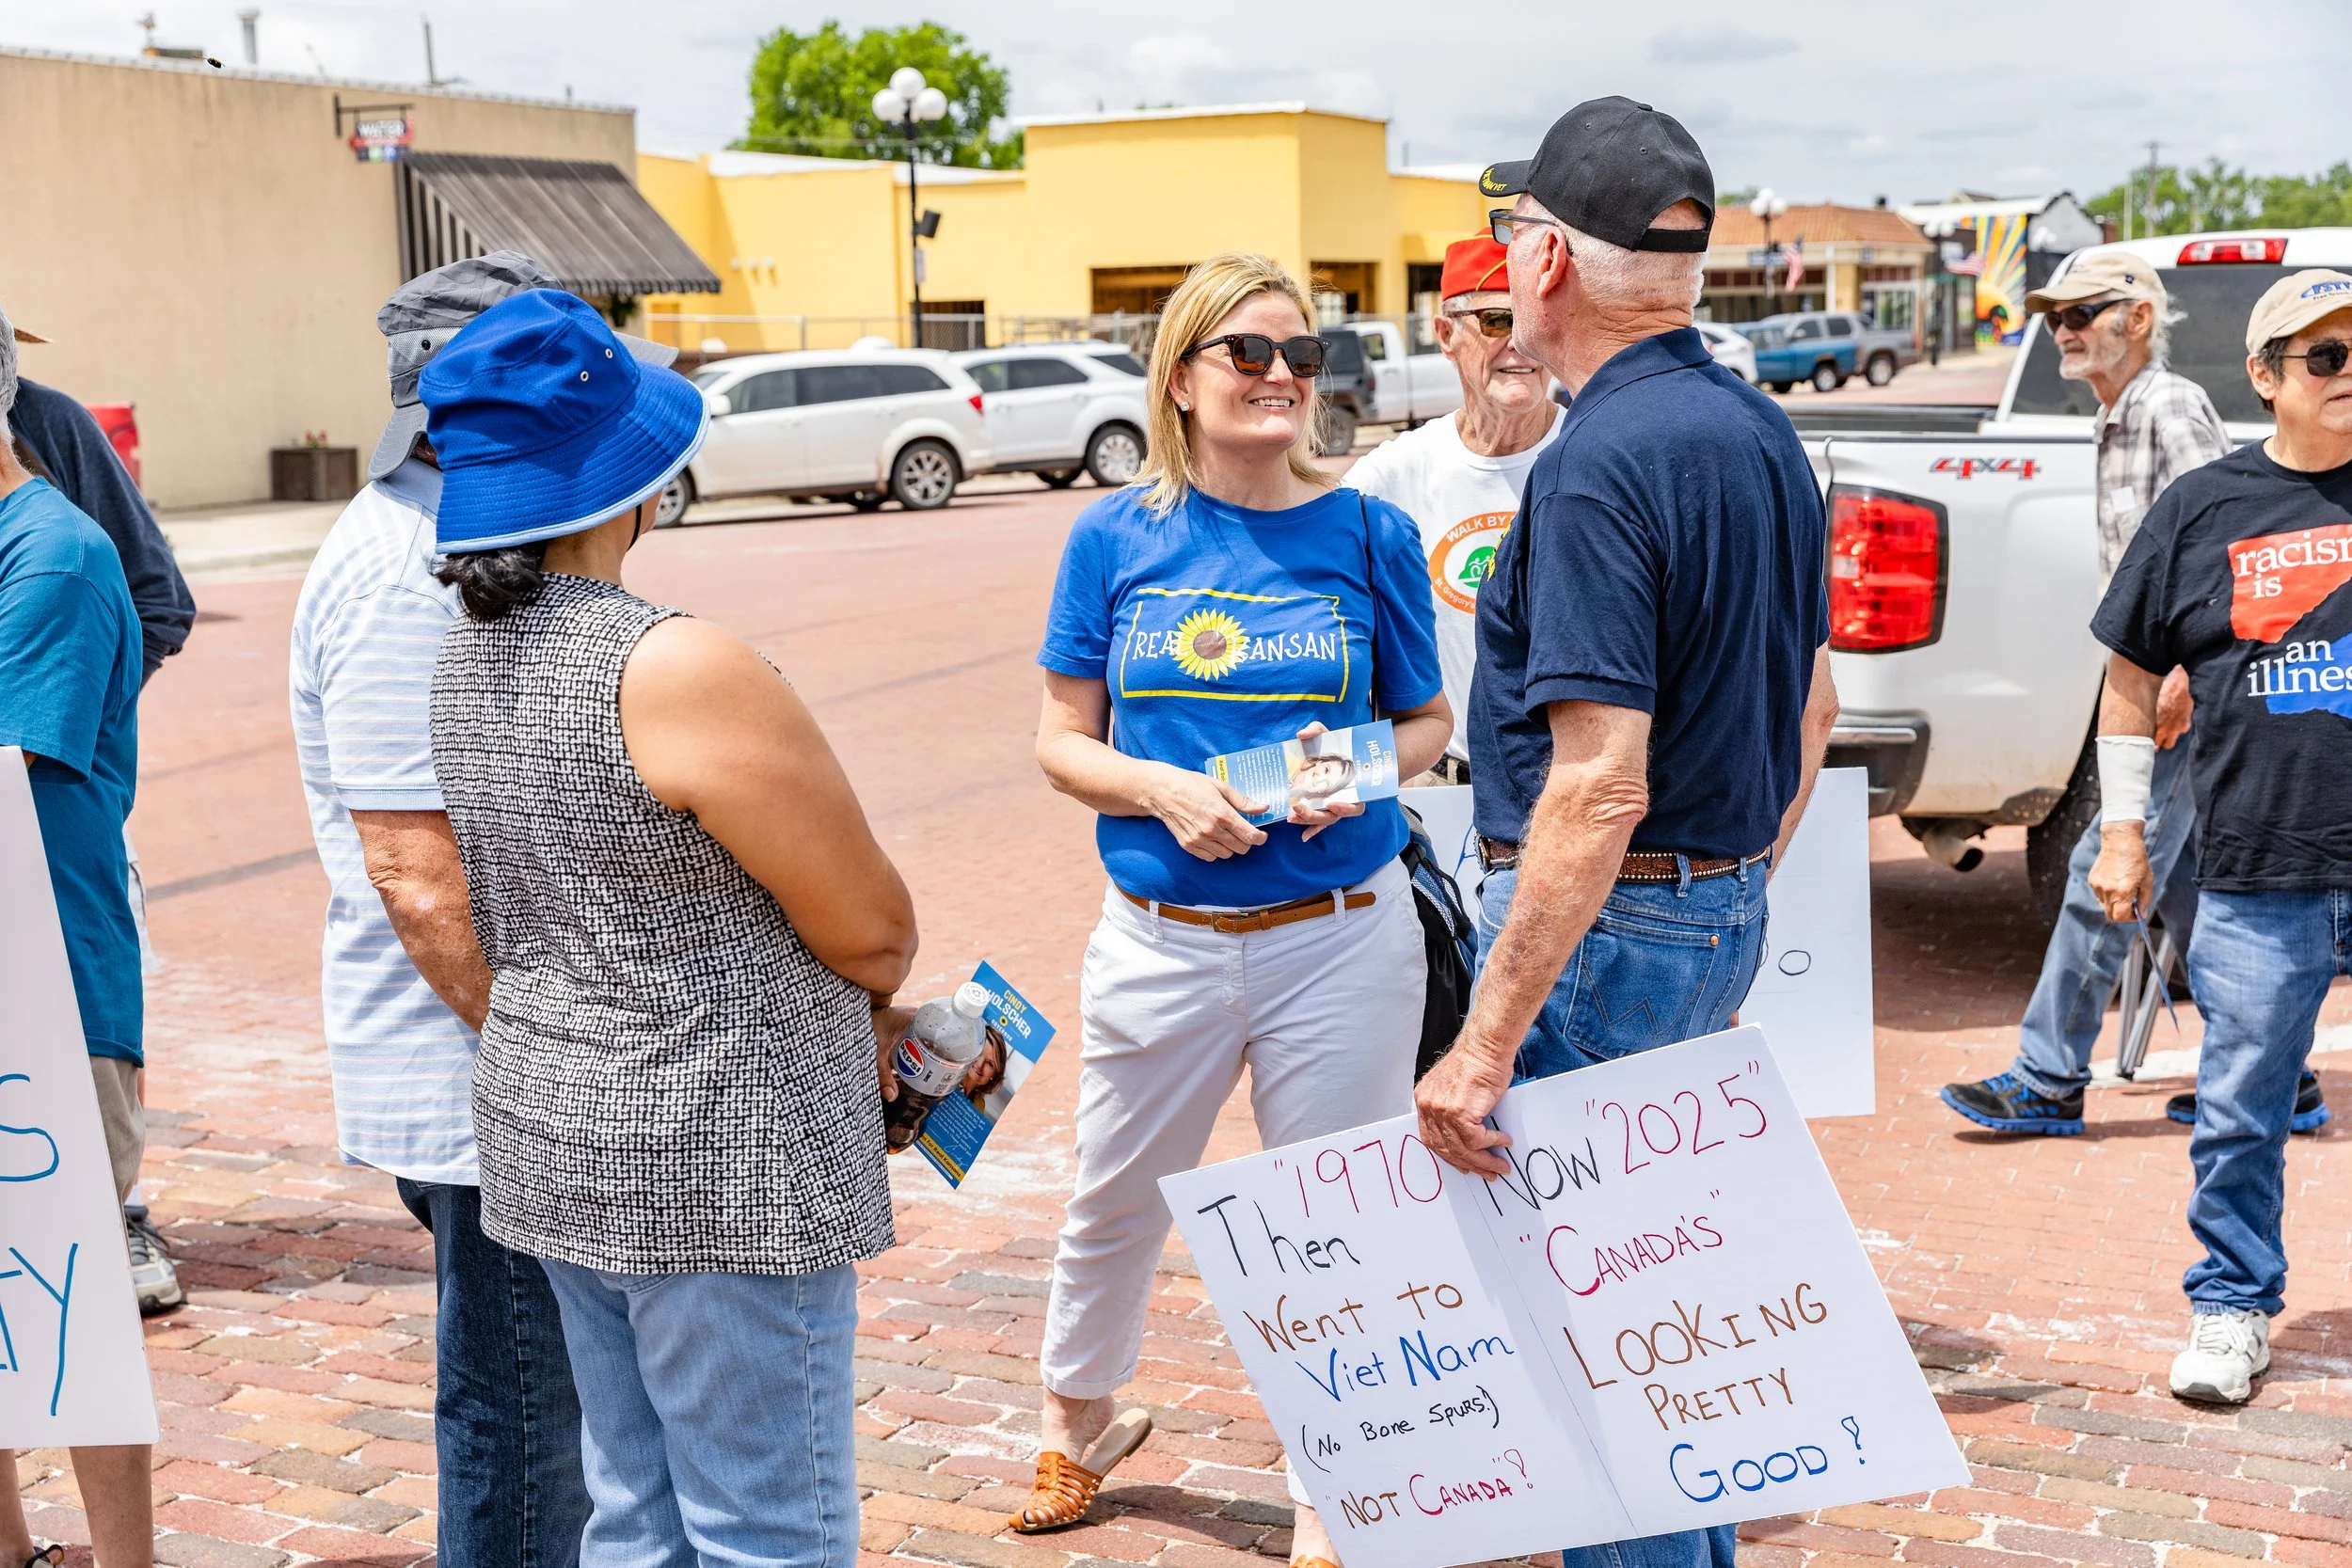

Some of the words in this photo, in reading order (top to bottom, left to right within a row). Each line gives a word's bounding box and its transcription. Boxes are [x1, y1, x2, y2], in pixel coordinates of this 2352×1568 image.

[1446, 517, 1485, 543] WALK
[1486, 515, 1507, 528] BY
[2251, 573, 2282, 599] is
[1132, 630, 1188, 660] REAL
[1230, 631, 1336, 663] KANSAN
[2285, 639, 2334, 664] an
[987, 989, 1032, 1039] HOLSCHER
[1003, 990, 1027, 1014] CINDY
[900, 1042, 921, 1073] PEPSI
[932, 1147, 944, 1159] Real
[942, 1157, 961, 1177] Kansans
[1197, 1194, 1360, 1276] Then
[1242, 1294, 1365, 1354] Went
[1563, 1282, 1828, 1390] LOOKING
[1295, 1347, 1387, 1402] Viet
[1399, 1329, 1515, 1387] Nam
[1644, 1367, 1794, 1431] PRETTY
[1359, 1419, 1415, 1442] Bone
